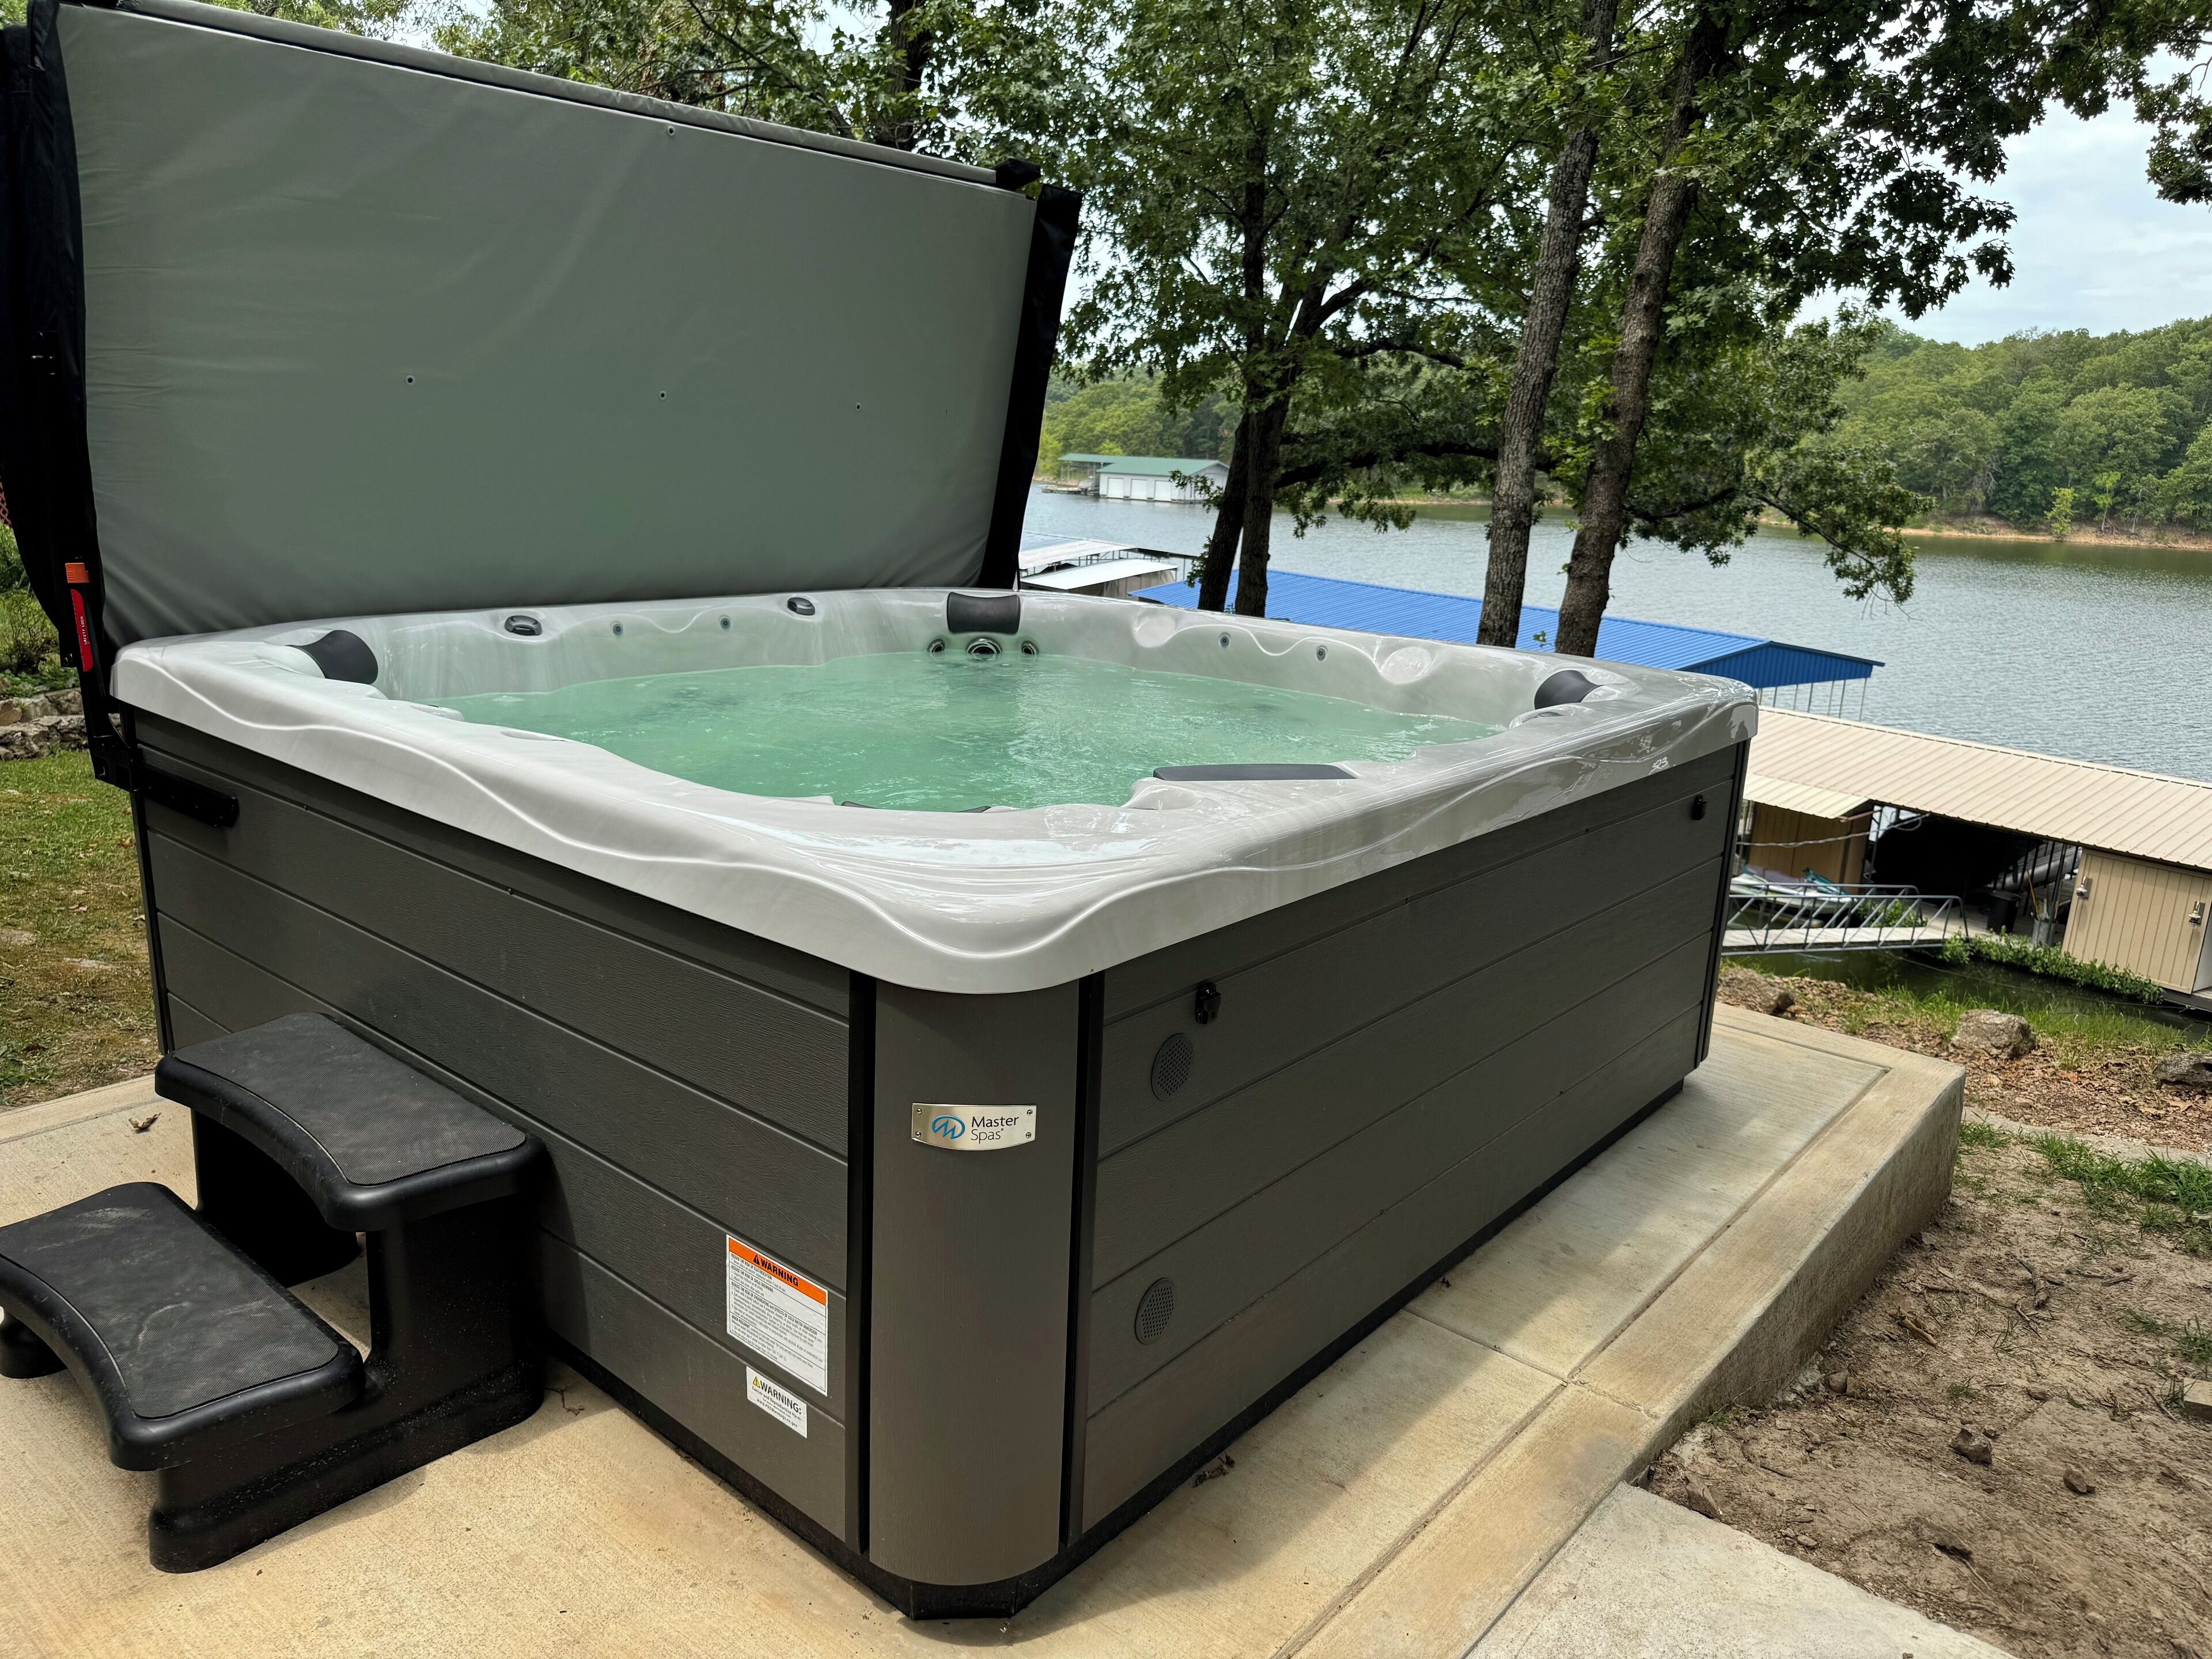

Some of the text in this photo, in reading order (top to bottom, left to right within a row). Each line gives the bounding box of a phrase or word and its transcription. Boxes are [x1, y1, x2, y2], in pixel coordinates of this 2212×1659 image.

[971, 1116, 1019, 1127] Master
[761, 1257, 798, 1287] WARNING
[760, 1380, 801, 1414] WARNING:
